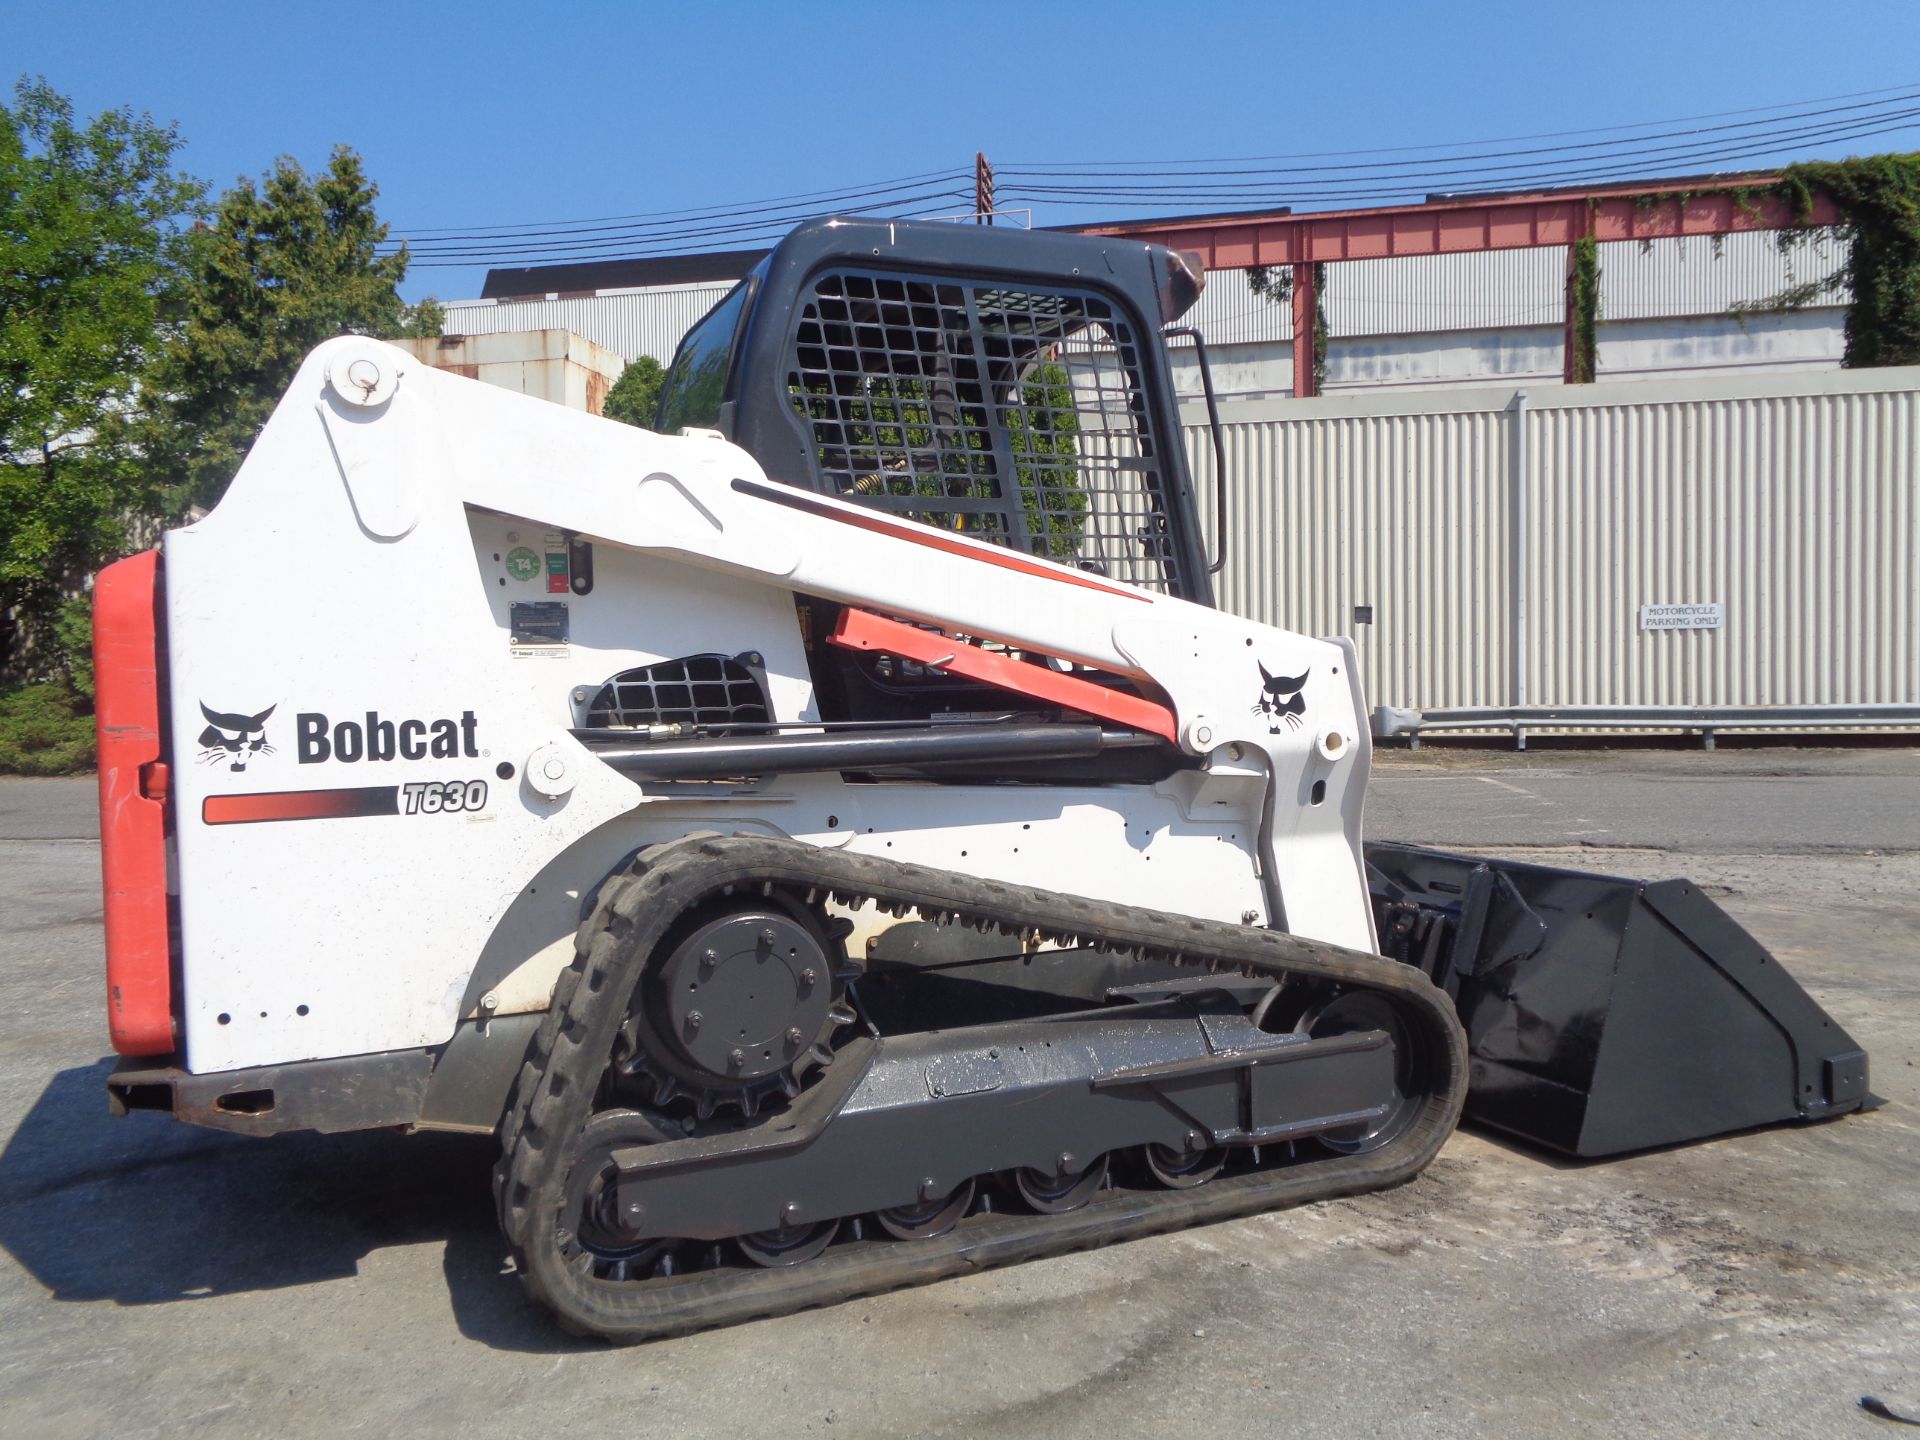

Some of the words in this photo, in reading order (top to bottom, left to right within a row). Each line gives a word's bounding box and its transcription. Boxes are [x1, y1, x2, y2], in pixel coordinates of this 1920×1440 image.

[515, 558, 532, 571] T4
[1648, 607, 1715, 616] MOTORCYCLE
[1645, 618, 1690, 626] PARKING
[1694, 617, 1720, 625] ONLY
[296, 710, 479, 764] Bobcat
[403, 779, 488, 815] T630
